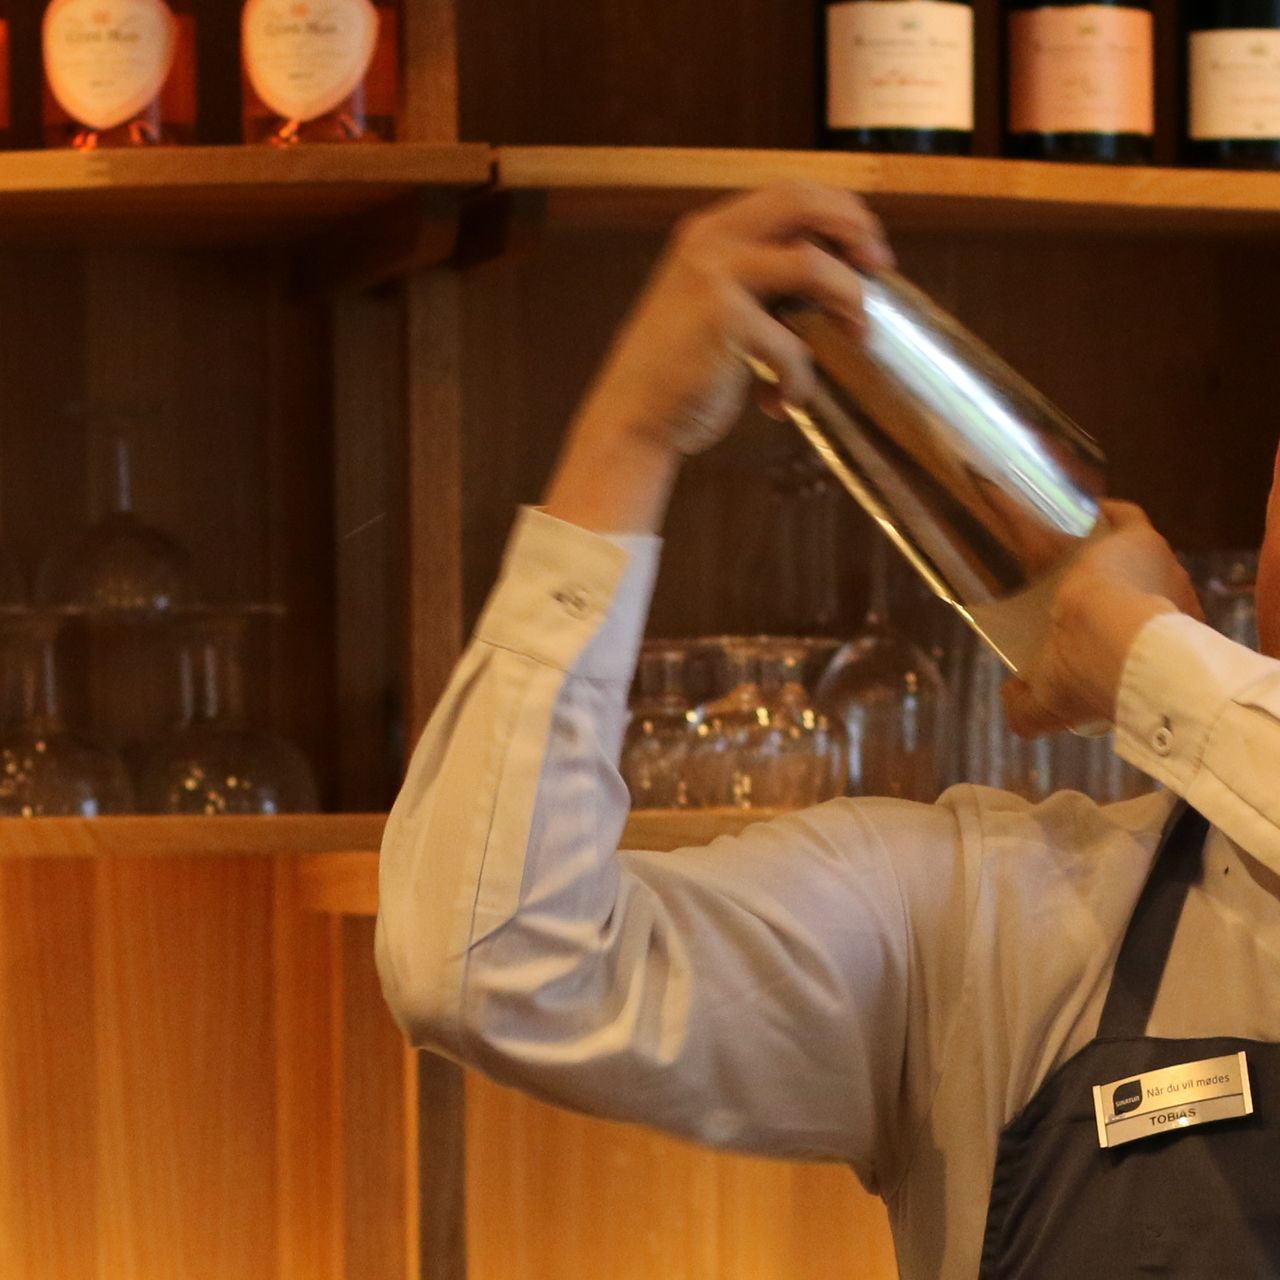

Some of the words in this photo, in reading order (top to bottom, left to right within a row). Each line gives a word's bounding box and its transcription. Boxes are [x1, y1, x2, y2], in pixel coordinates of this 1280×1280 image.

[1147, 1087, 1164, 1098] Når
[1167, 1084, 1180, 1093] du
[1182, 1079, 1194, 1090] vil
[1196, 1074, 1231, 1087] mødes
[1149, 1108, 1197, 1125] TOBIAS
